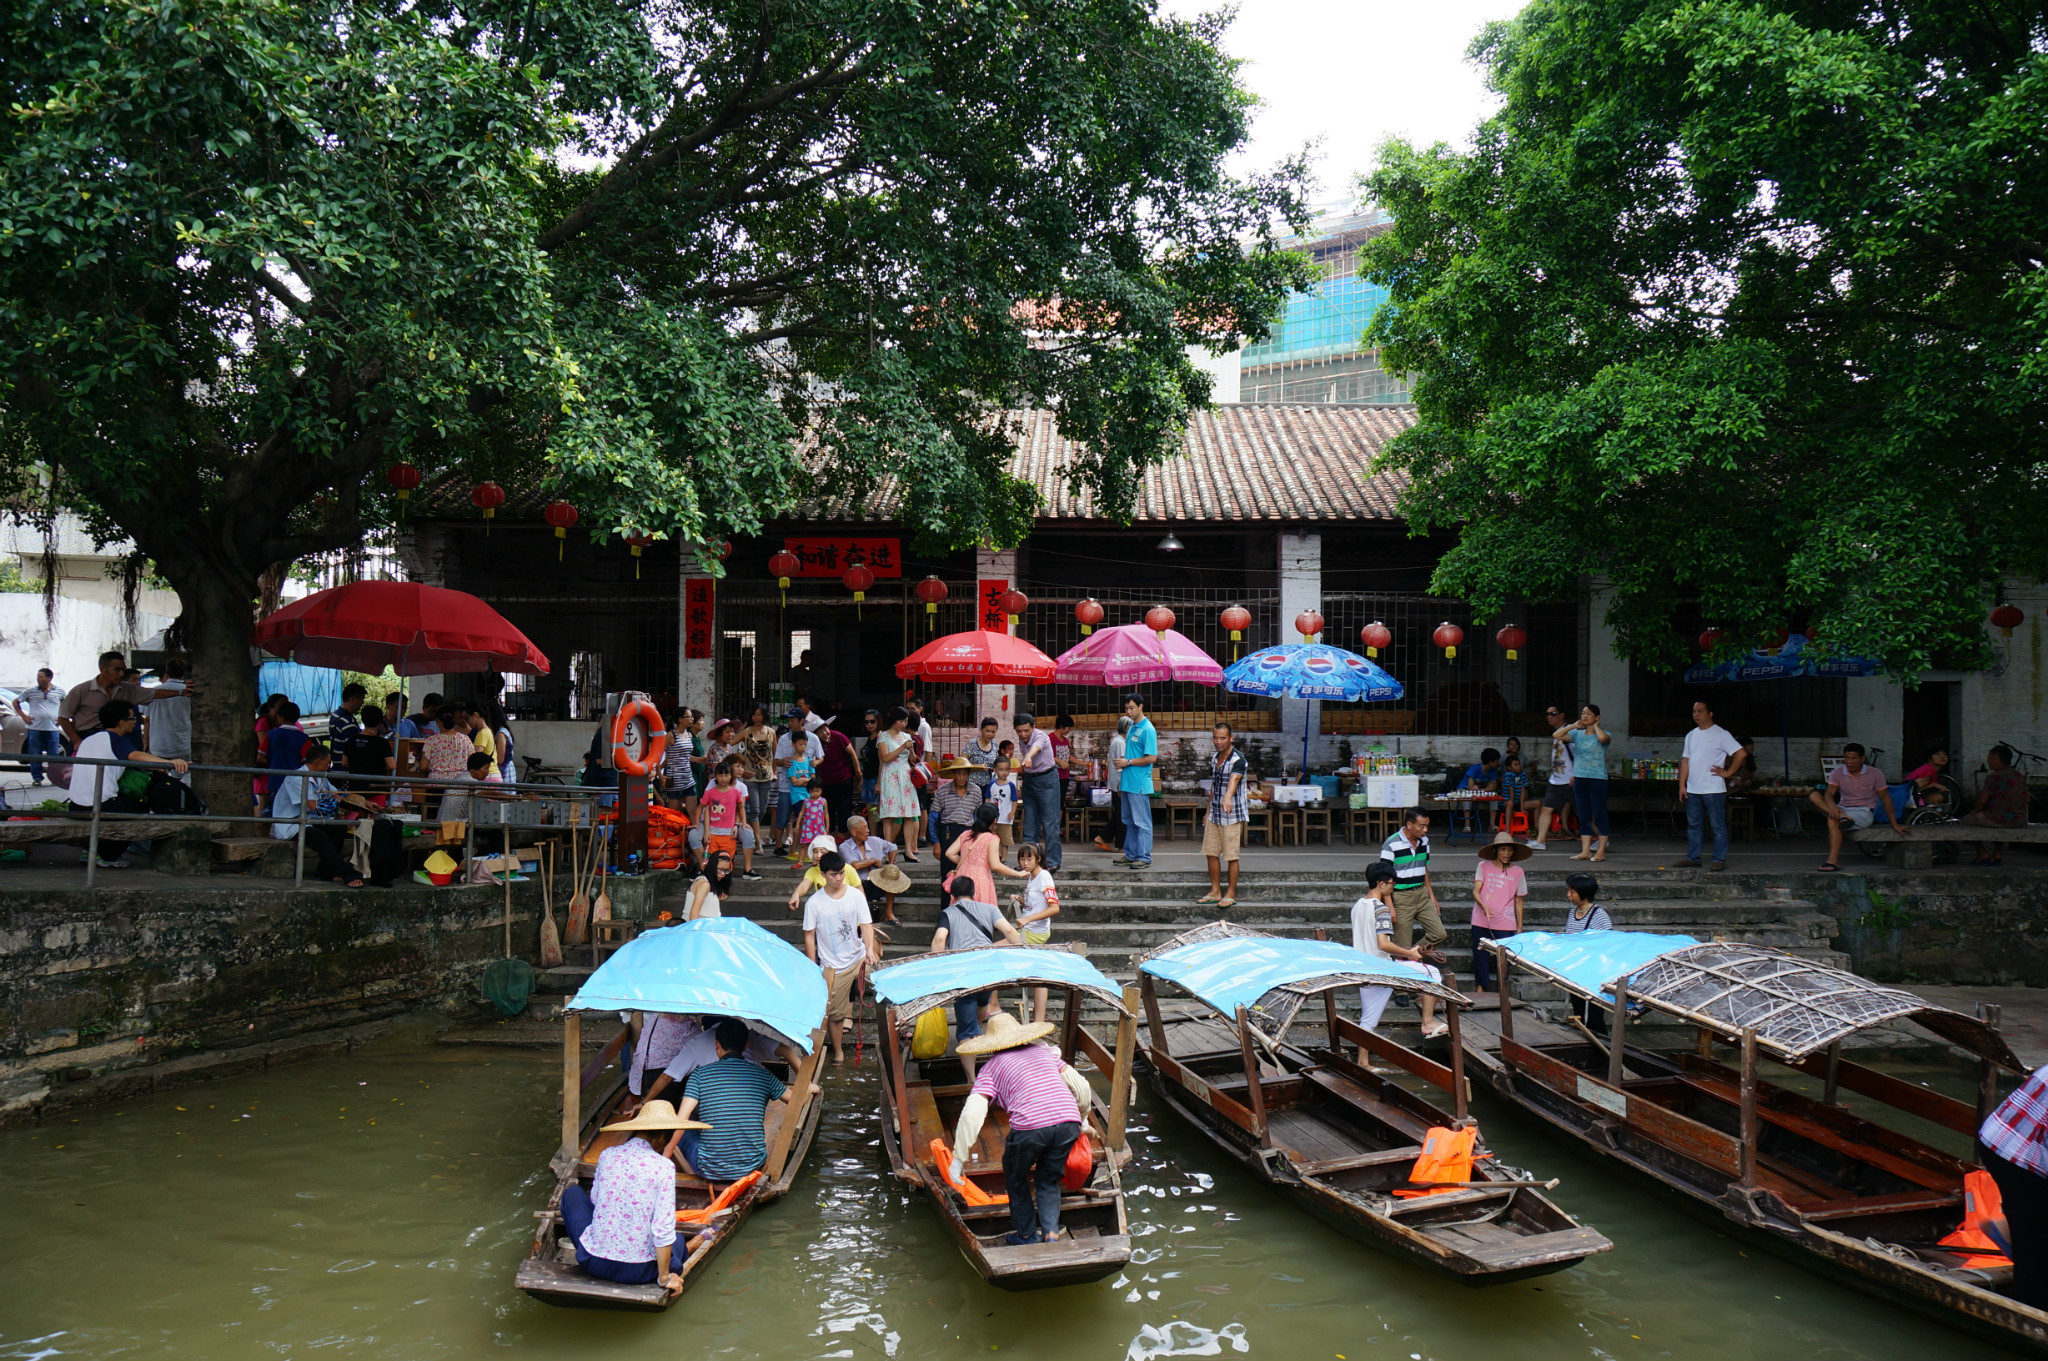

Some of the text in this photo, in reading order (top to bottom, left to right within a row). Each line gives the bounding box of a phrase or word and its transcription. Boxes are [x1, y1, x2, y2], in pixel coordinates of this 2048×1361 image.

[1742, 665, 1784, 677] PEPSI
[1237, 680, 1269, 691] PEPSI
[1301, 685, 1344, 696] 百事可乐
[1369, 687, 1392, 697] PEPSI
